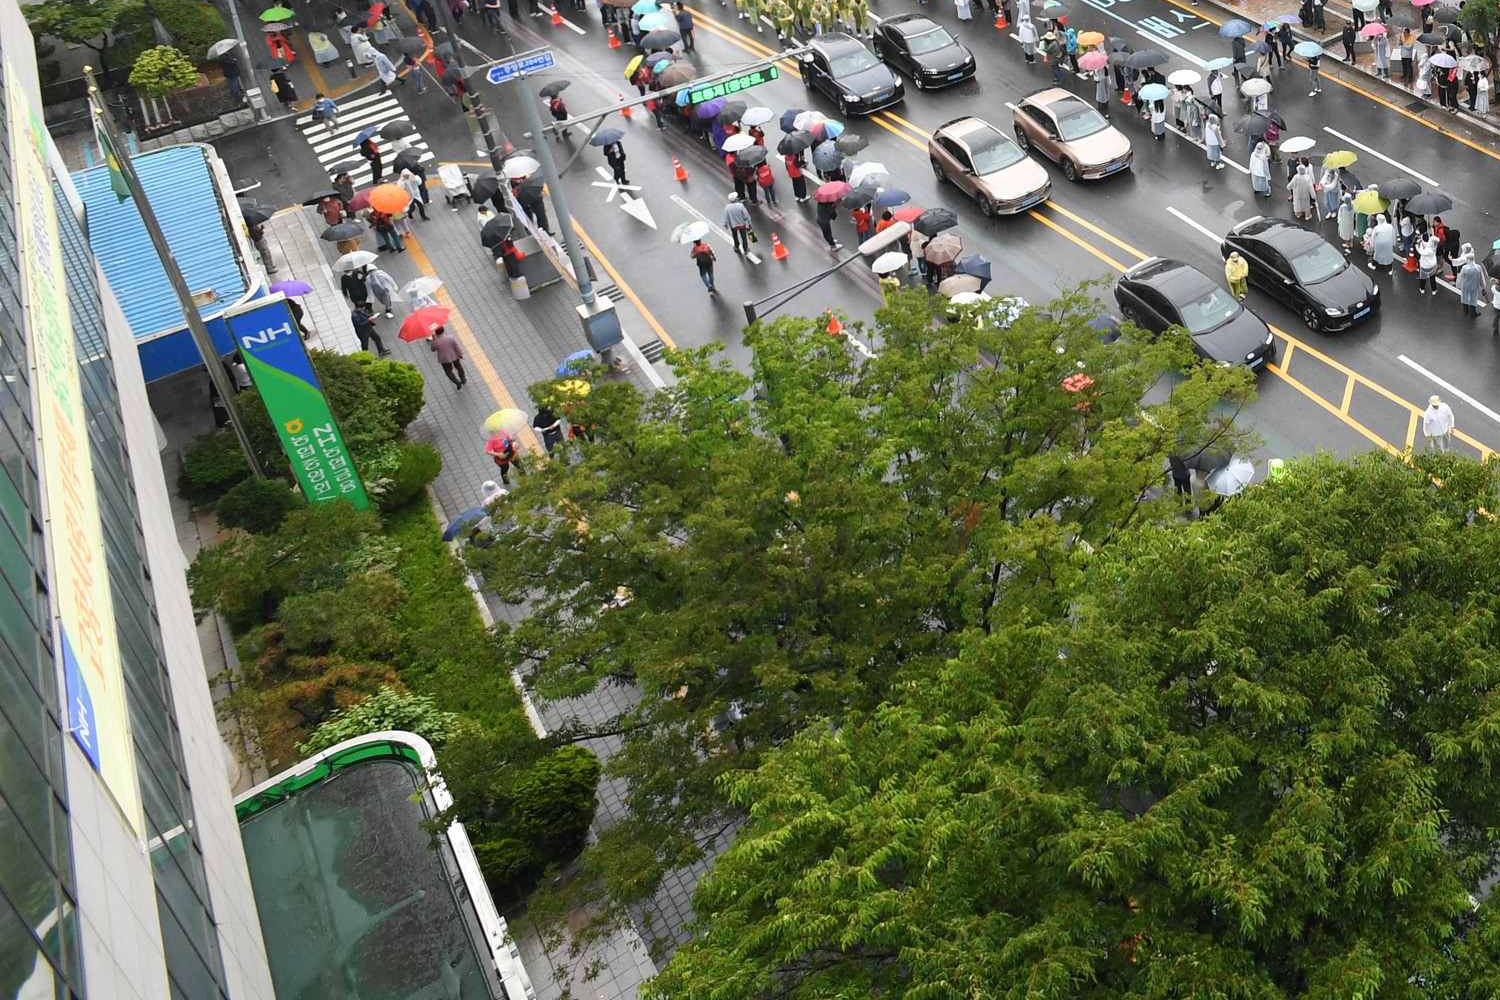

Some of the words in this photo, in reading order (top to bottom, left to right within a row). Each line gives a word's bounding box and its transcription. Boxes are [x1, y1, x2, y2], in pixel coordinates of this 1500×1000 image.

[1137, 9, 1211, 39] 버스
[241, 321, 292, 349] NH
[76, 696, 91, 750] NH
